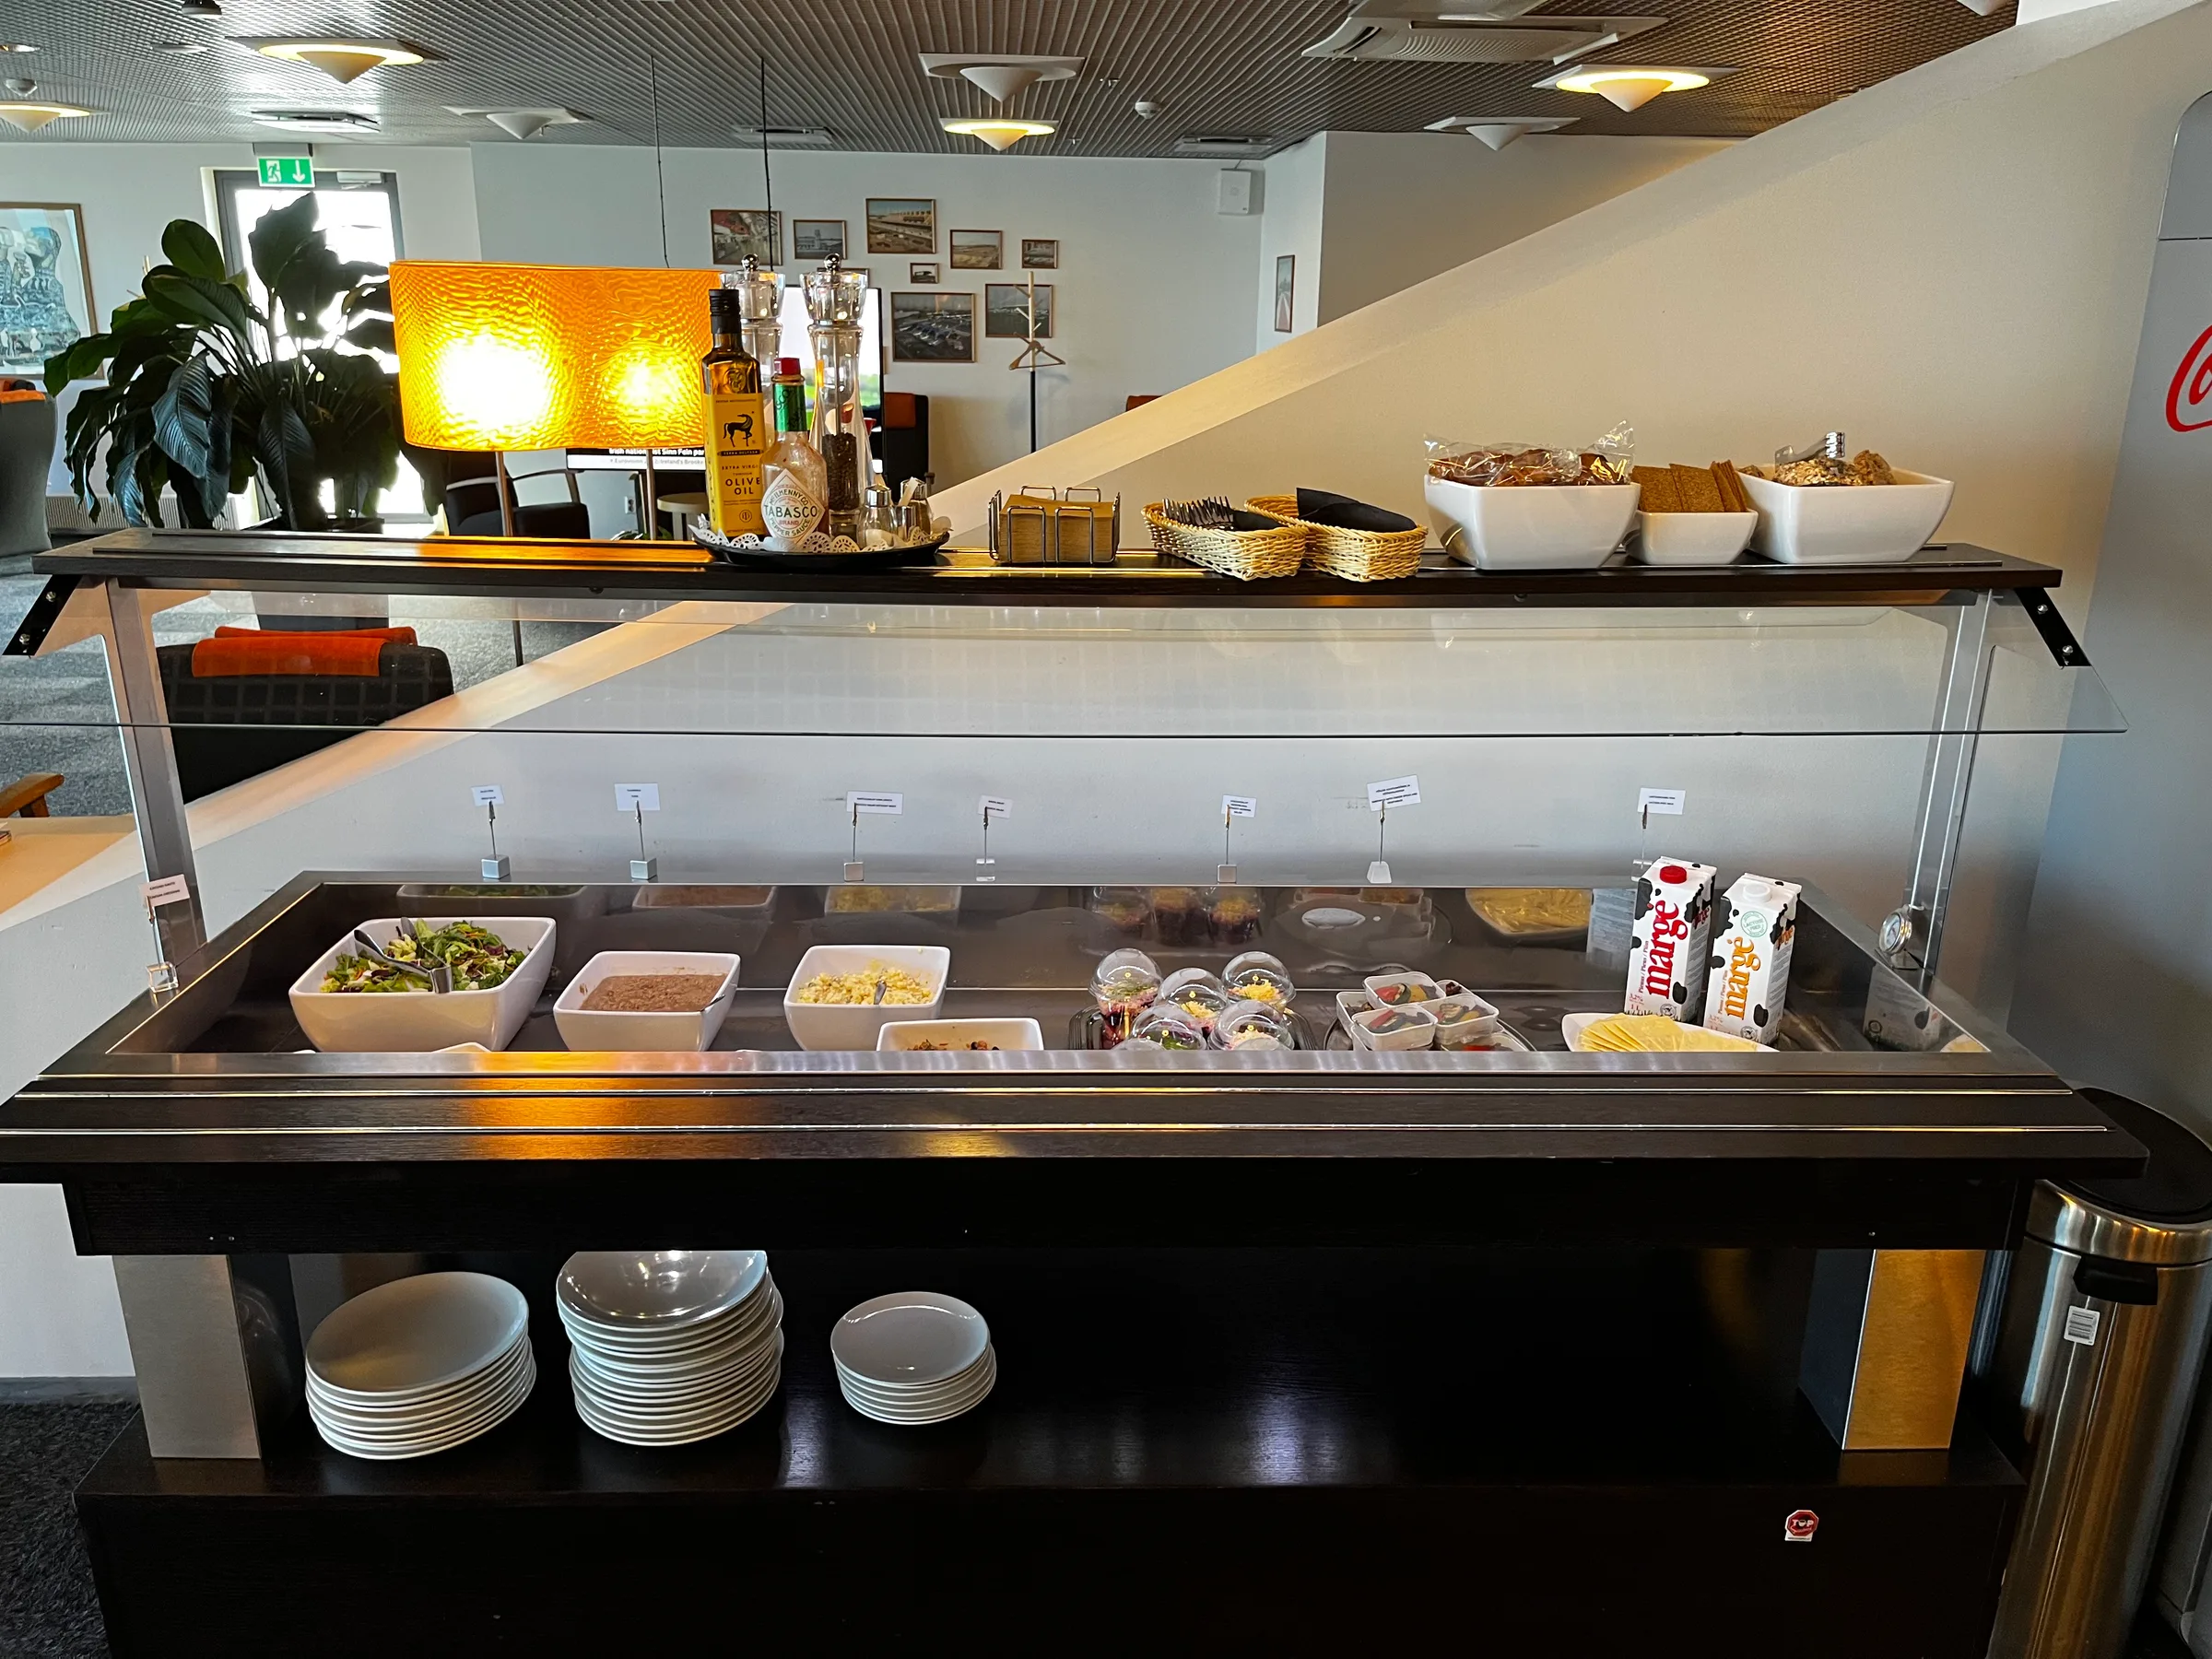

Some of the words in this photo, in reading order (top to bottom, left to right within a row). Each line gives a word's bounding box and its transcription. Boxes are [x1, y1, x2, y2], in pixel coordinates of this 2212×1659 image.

[725, 477, 760, 487] OLIVE
[734, 487, 754, 495] OIL
[764, 504, 818, 518] TABASCO
[792, 519, 810, 535] SAUCE
